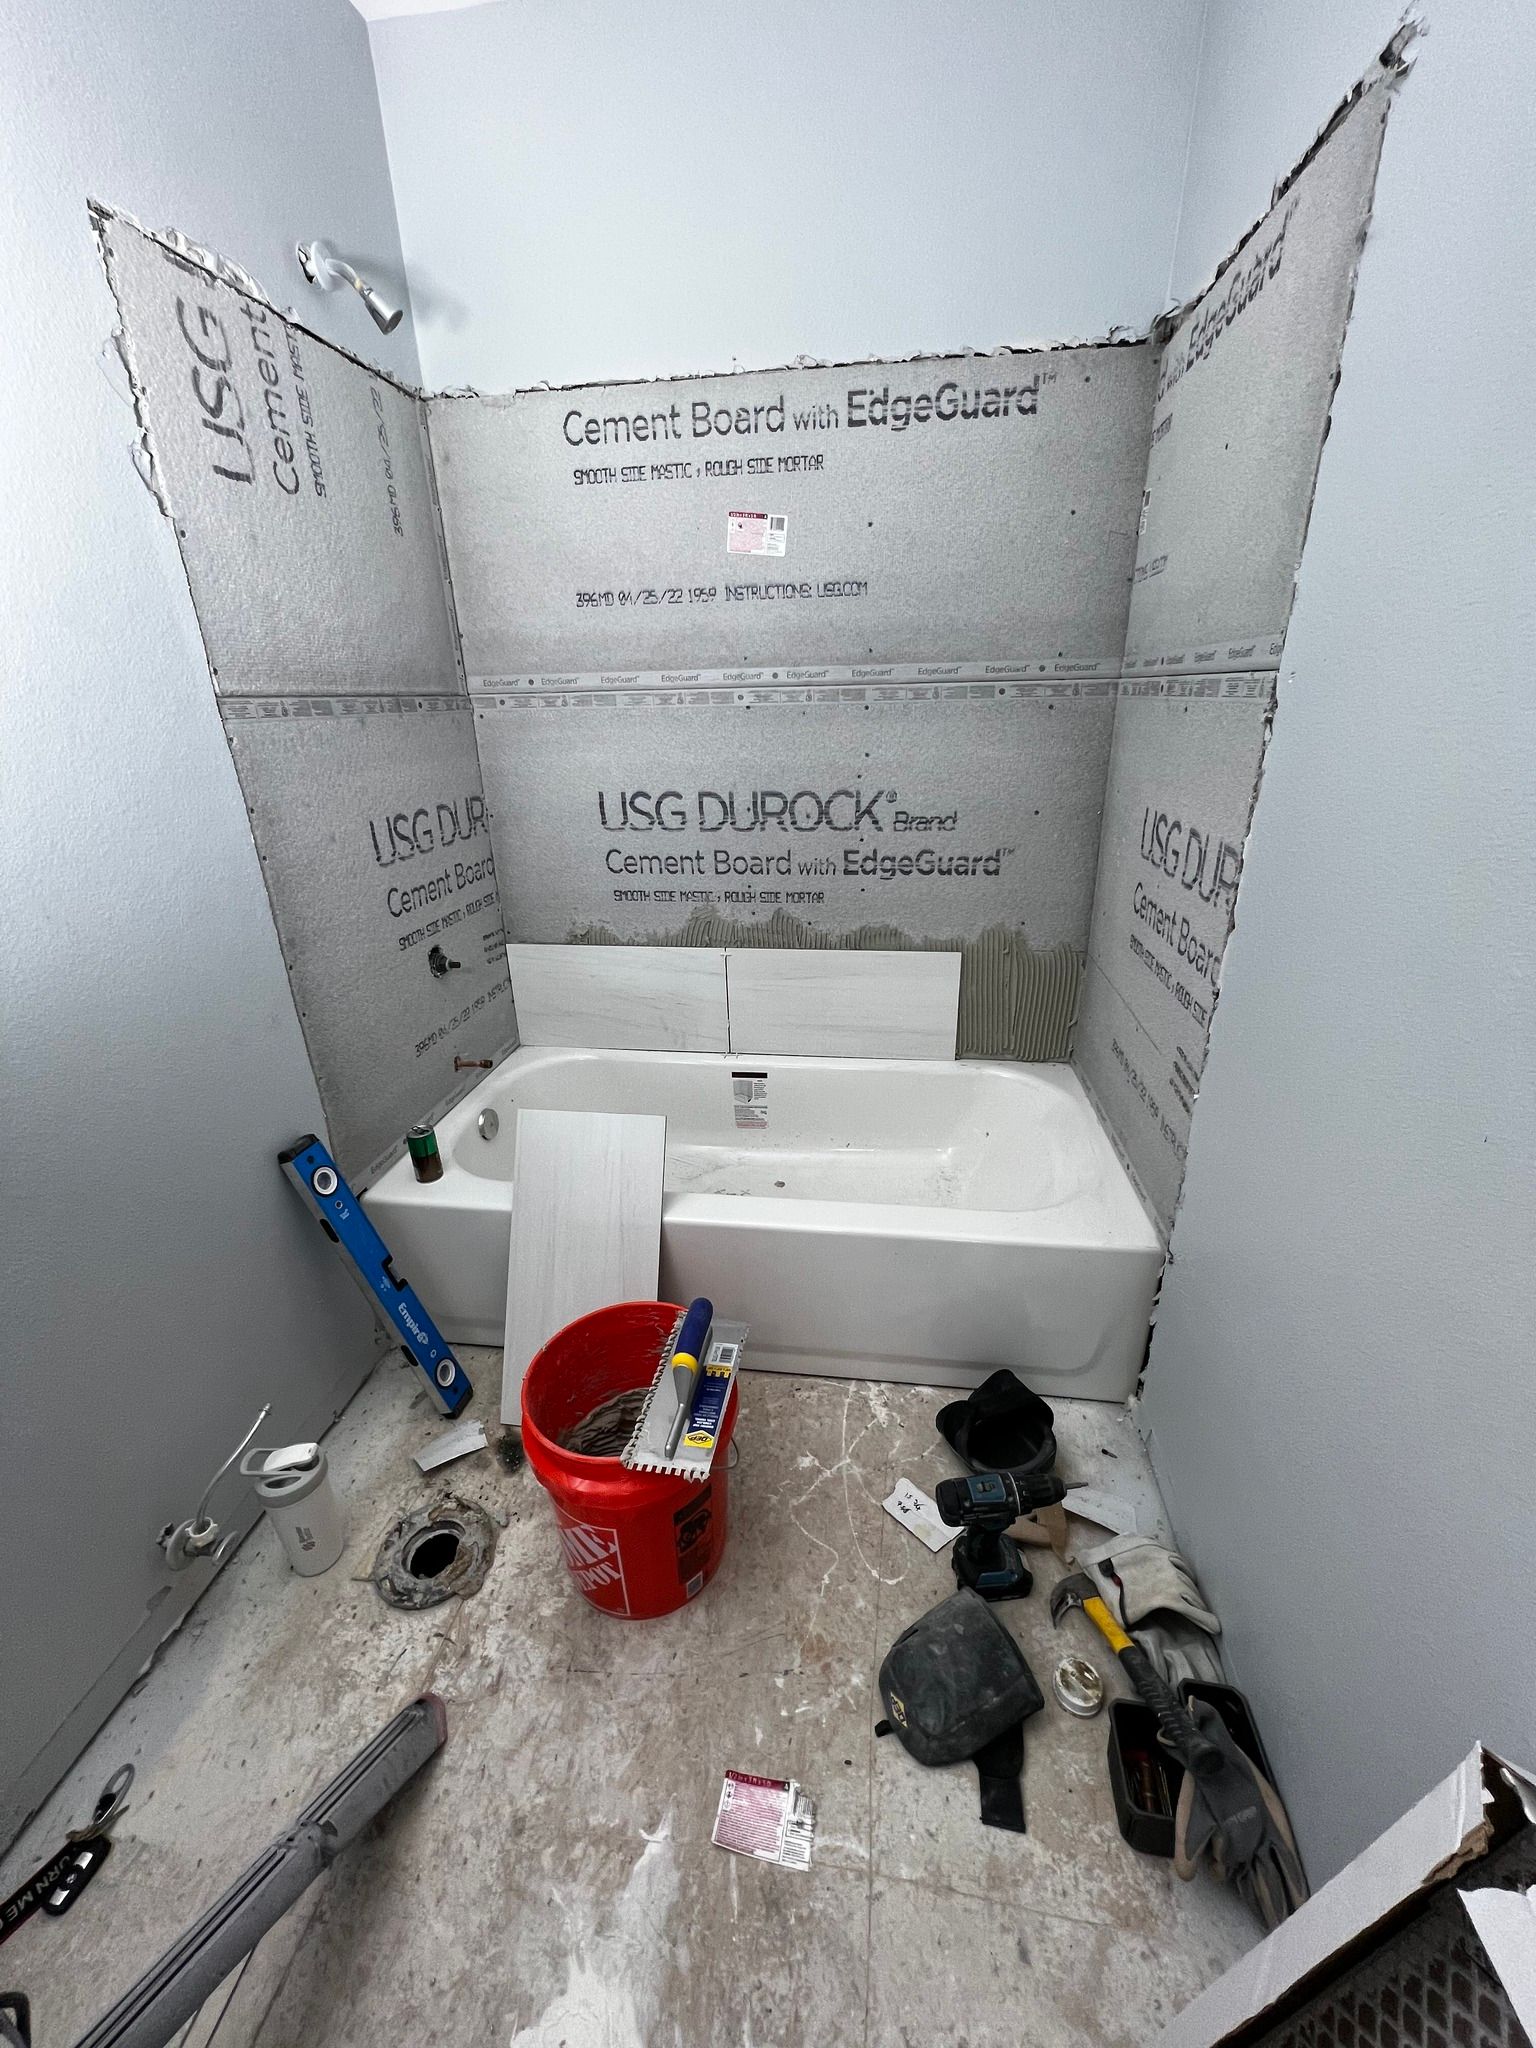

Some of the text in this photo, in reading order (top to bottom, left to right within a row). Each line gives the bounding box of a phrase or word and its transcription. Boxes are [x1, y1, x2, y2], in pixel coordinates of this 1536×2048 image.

[177, 297, 254, 486] USG
[240, 303, 299, 496] Cement
[562, 410, 682, 447] Cement
[692, 395, 785, 438] Board
[792, 403, 839, 431] with
[573, 464, 617, 487] SMOOTH
[620, 462, 647, 483] SIDE
[705, 458, 744, 479] ROUGH
[747, 455, 774, 475] SIDE
[777, 453, 824, 474] MORTAR
[369, 806, 434, 868] USG
[598, 792, 686, 832] USG
[893, 811, 957, 832] Brand
[605, 848, 705, 876] Cement
[713, 849, 791, 876] Board
[798, 856, 837, 876] with
[1140, 807, 1182, 878] USG
[387, 868, 452, 918] Cement
[613, 889, 650, 902] SMOOTH
[653, 890, 676, 903] SIDE
[759, 891, 781, 904] SIDE
[785, 892, 825, 905] MORTAR
[1133, 881, 1176, 947] Cement
